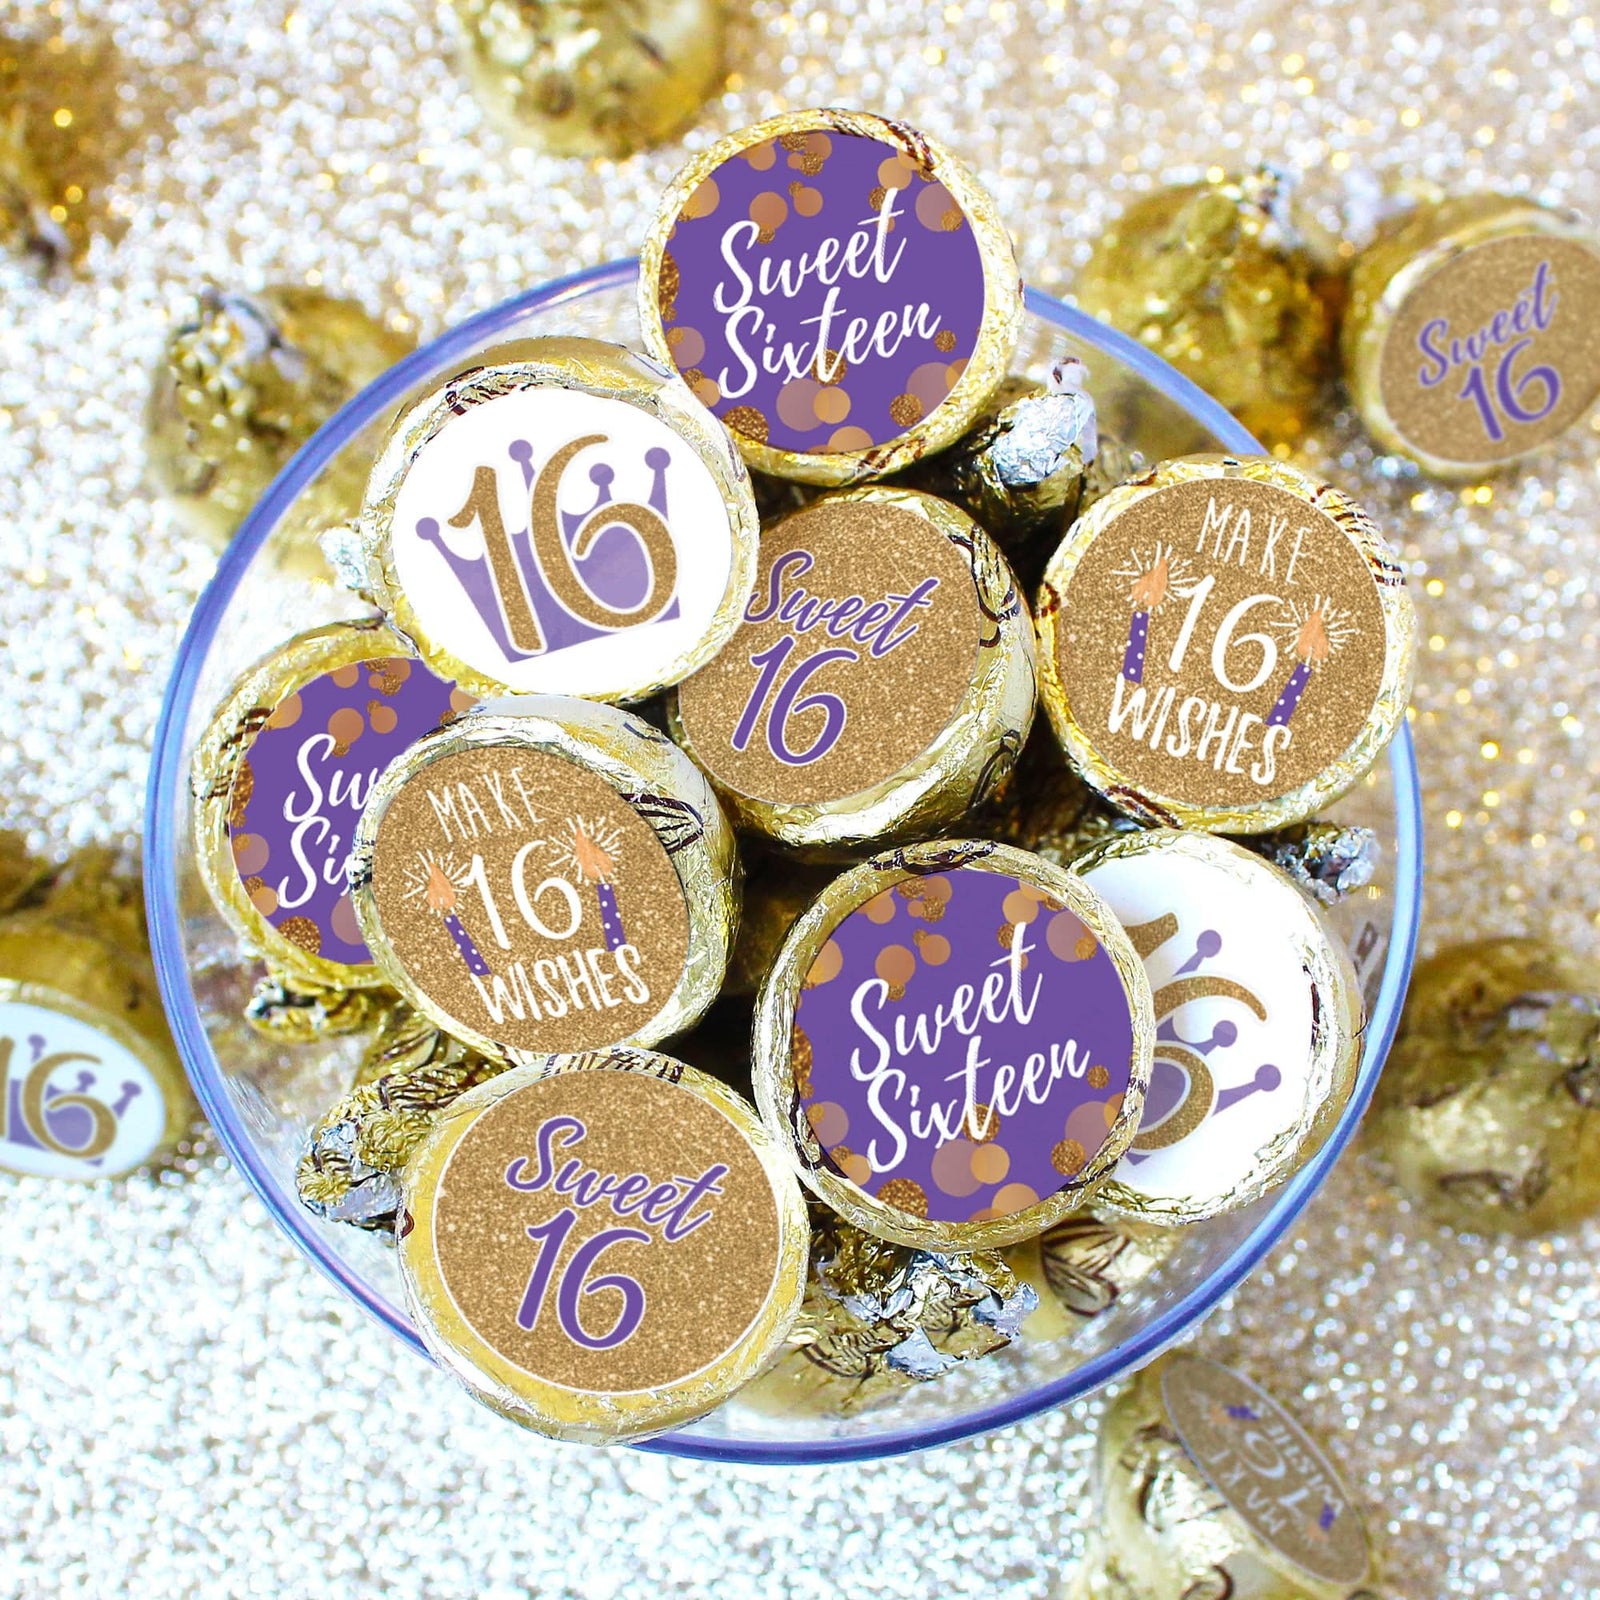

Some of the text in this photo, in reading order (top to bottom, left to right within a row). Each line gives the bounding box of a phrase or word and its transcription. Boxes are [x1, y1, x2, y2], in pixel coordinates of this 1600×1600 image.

[713, 187, 907, 314] Sweet
[718, 286, 942, 399] Sixteen
[1418, 261, 1558, 387] Sweet
[1459, 338, 1560, 440] 16
[447, 433, 678, 652] 16
[1195, 496, 1313, 585] MAKE
[743, 550, 940, 658] Sweet
[1168, 574, 1285, 693] 16
[731, 635, 859, 766] 16
[1108, 672, 1293, 786] WISHES
[425, 766, 546, 843] MAKE
[456, 839, 583, 950] 16
[470, 943, 651, 1025] WISHES
[849, 921, 1043, 1082] Sweet
[866, 1035, 1091, 1173] Sixteen
[504, 1114, 729, 1243] Sweet
[515, 1208, 653, 1350] 16
[1241, 1430, 1311, 1508] 16
